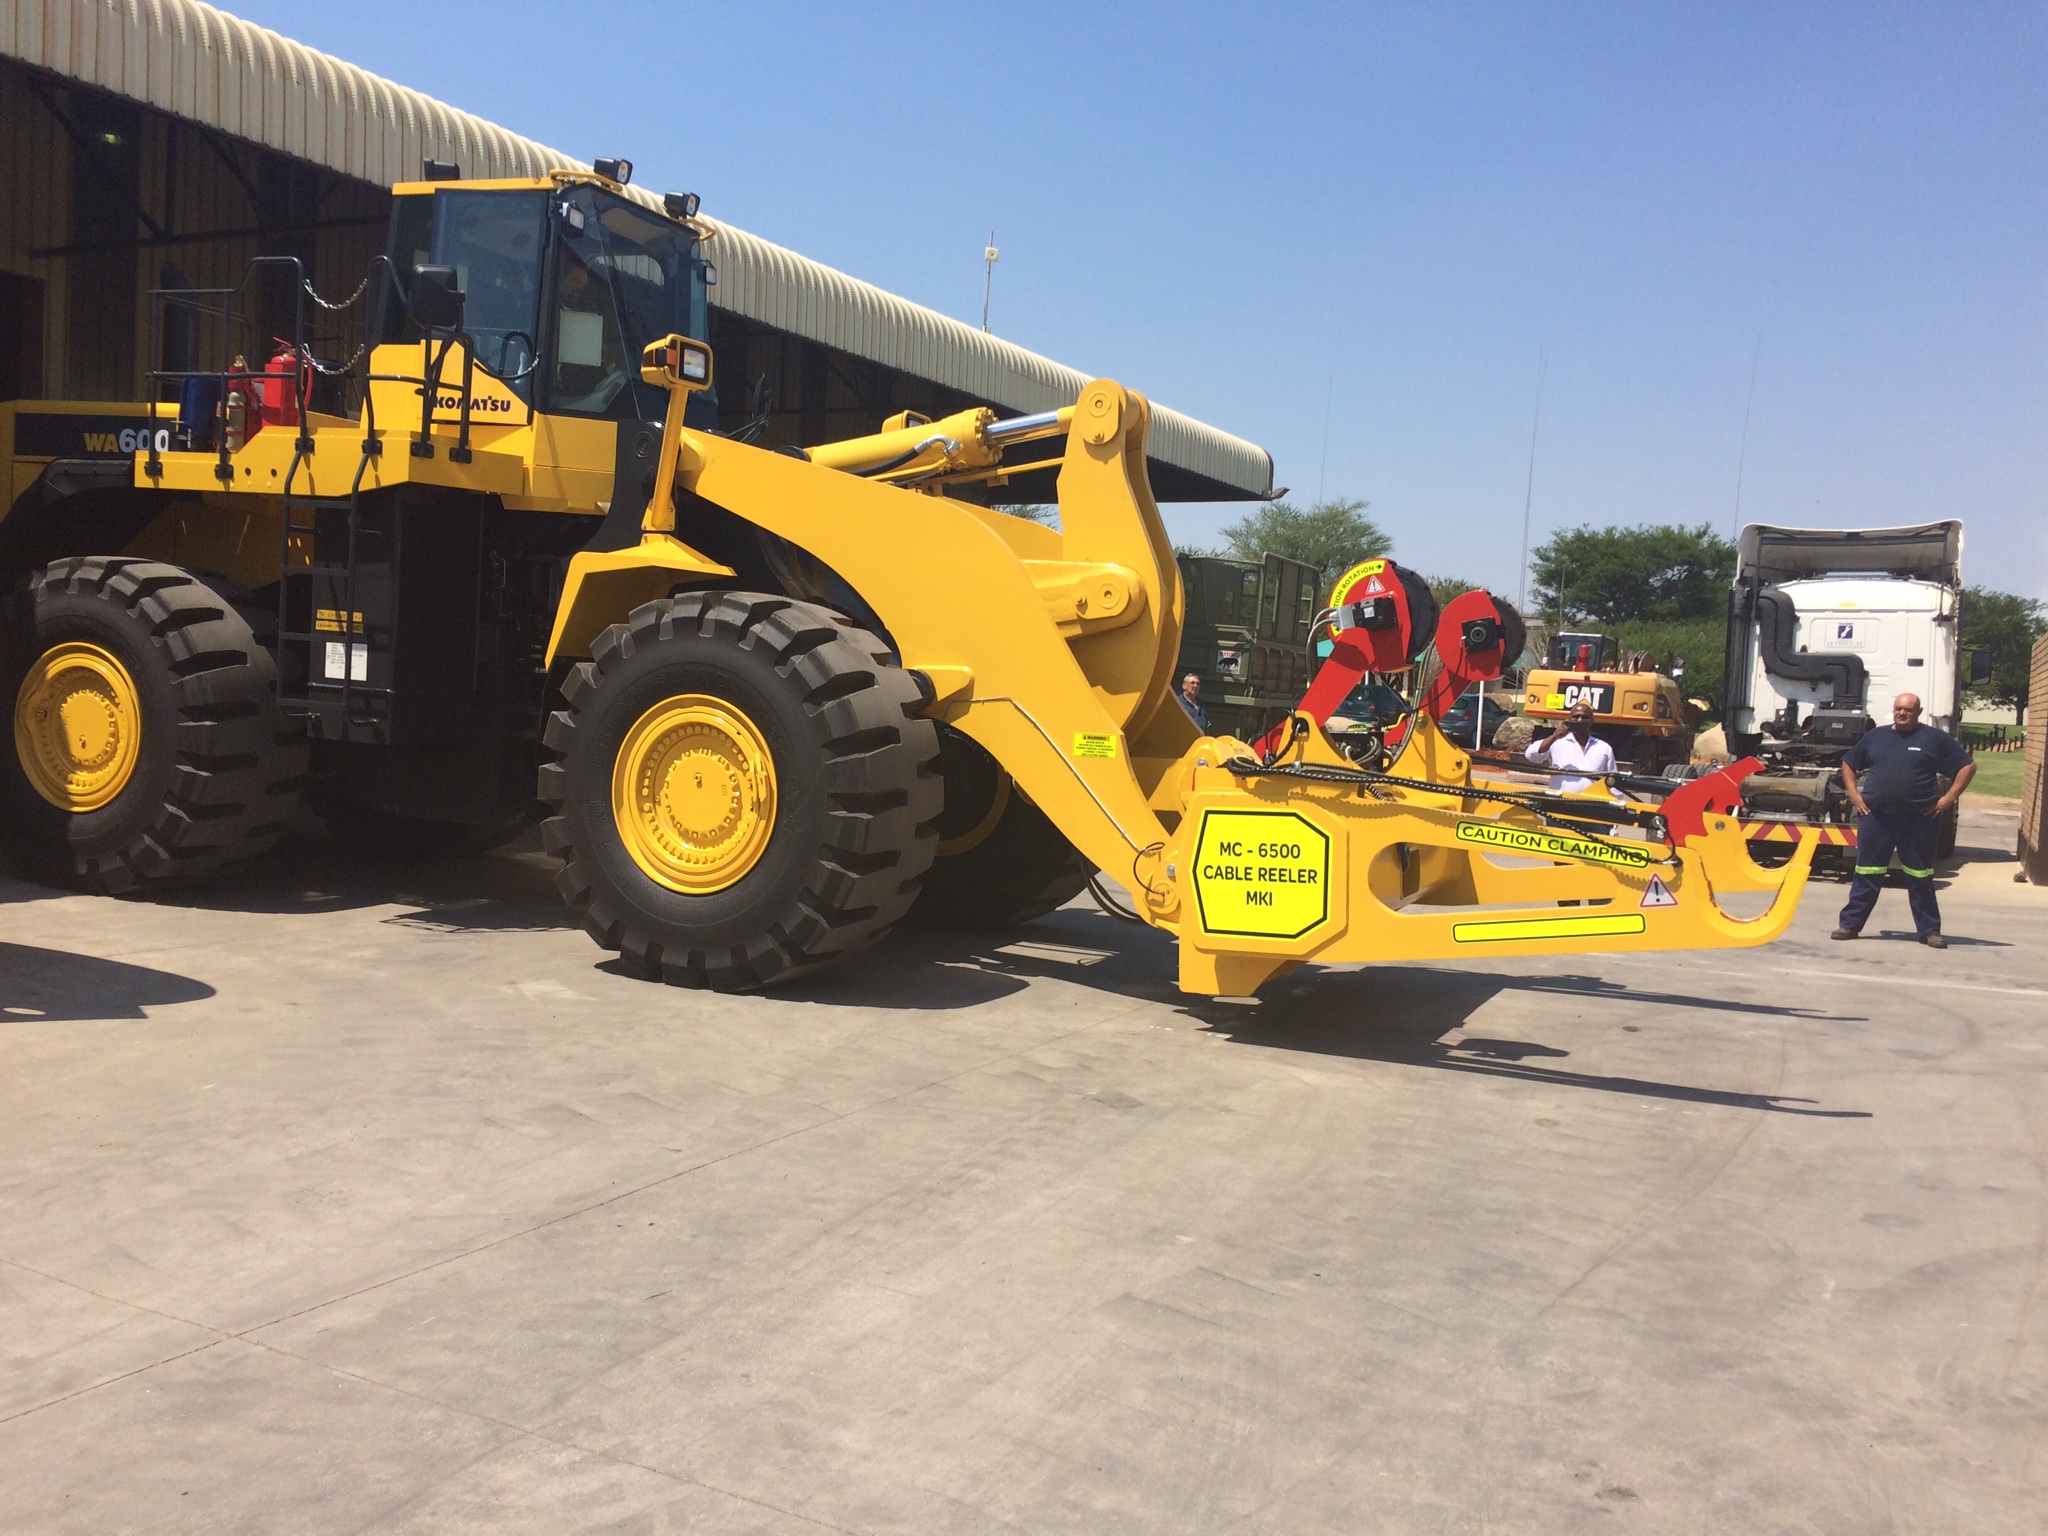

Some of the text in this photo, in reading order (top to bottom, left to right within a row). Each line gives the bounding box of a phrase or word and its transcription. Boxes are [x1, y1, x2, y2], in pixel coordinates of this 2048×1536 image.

[83, 428, 169, 453] WA600
[1341, 566, 1374, 589] ROTATION
[1564, 685, 1605, 710] CAT
[1219, 841, 1243, 857] MC
[1258, 843, 1301, 859] 6500
[1462, 826, 1643, 863] CAUTION CLAMPING
[1203, 864, 1318, 884] CABLE REELER
[1246, 890, 1273, 906] MKI
